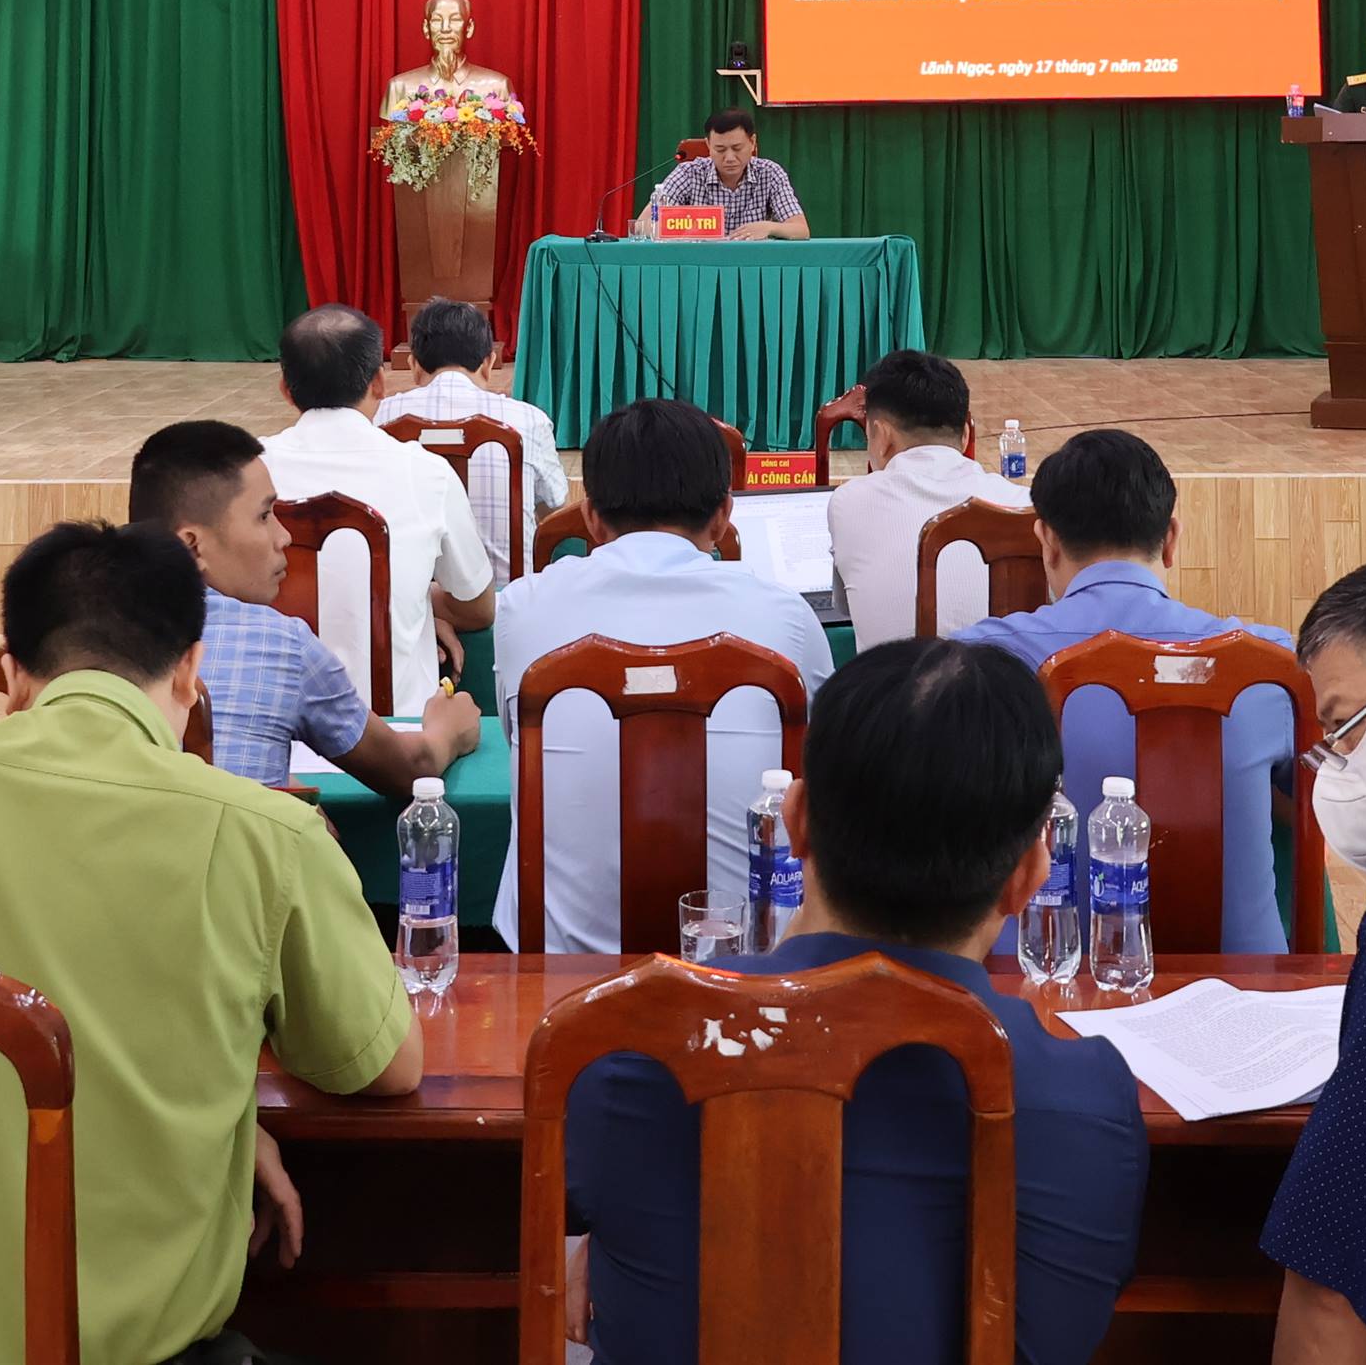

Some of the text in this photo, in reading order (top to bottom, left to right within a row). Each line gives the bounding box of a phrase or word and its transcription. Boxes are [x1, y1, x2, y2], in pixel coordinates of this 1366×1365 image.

[920, 58, 1179, 77] Lãnh Ngọc, ngày 17 tháng 7 năm 2026
[666, 213, 717, 230] CHỦ TRÌ
